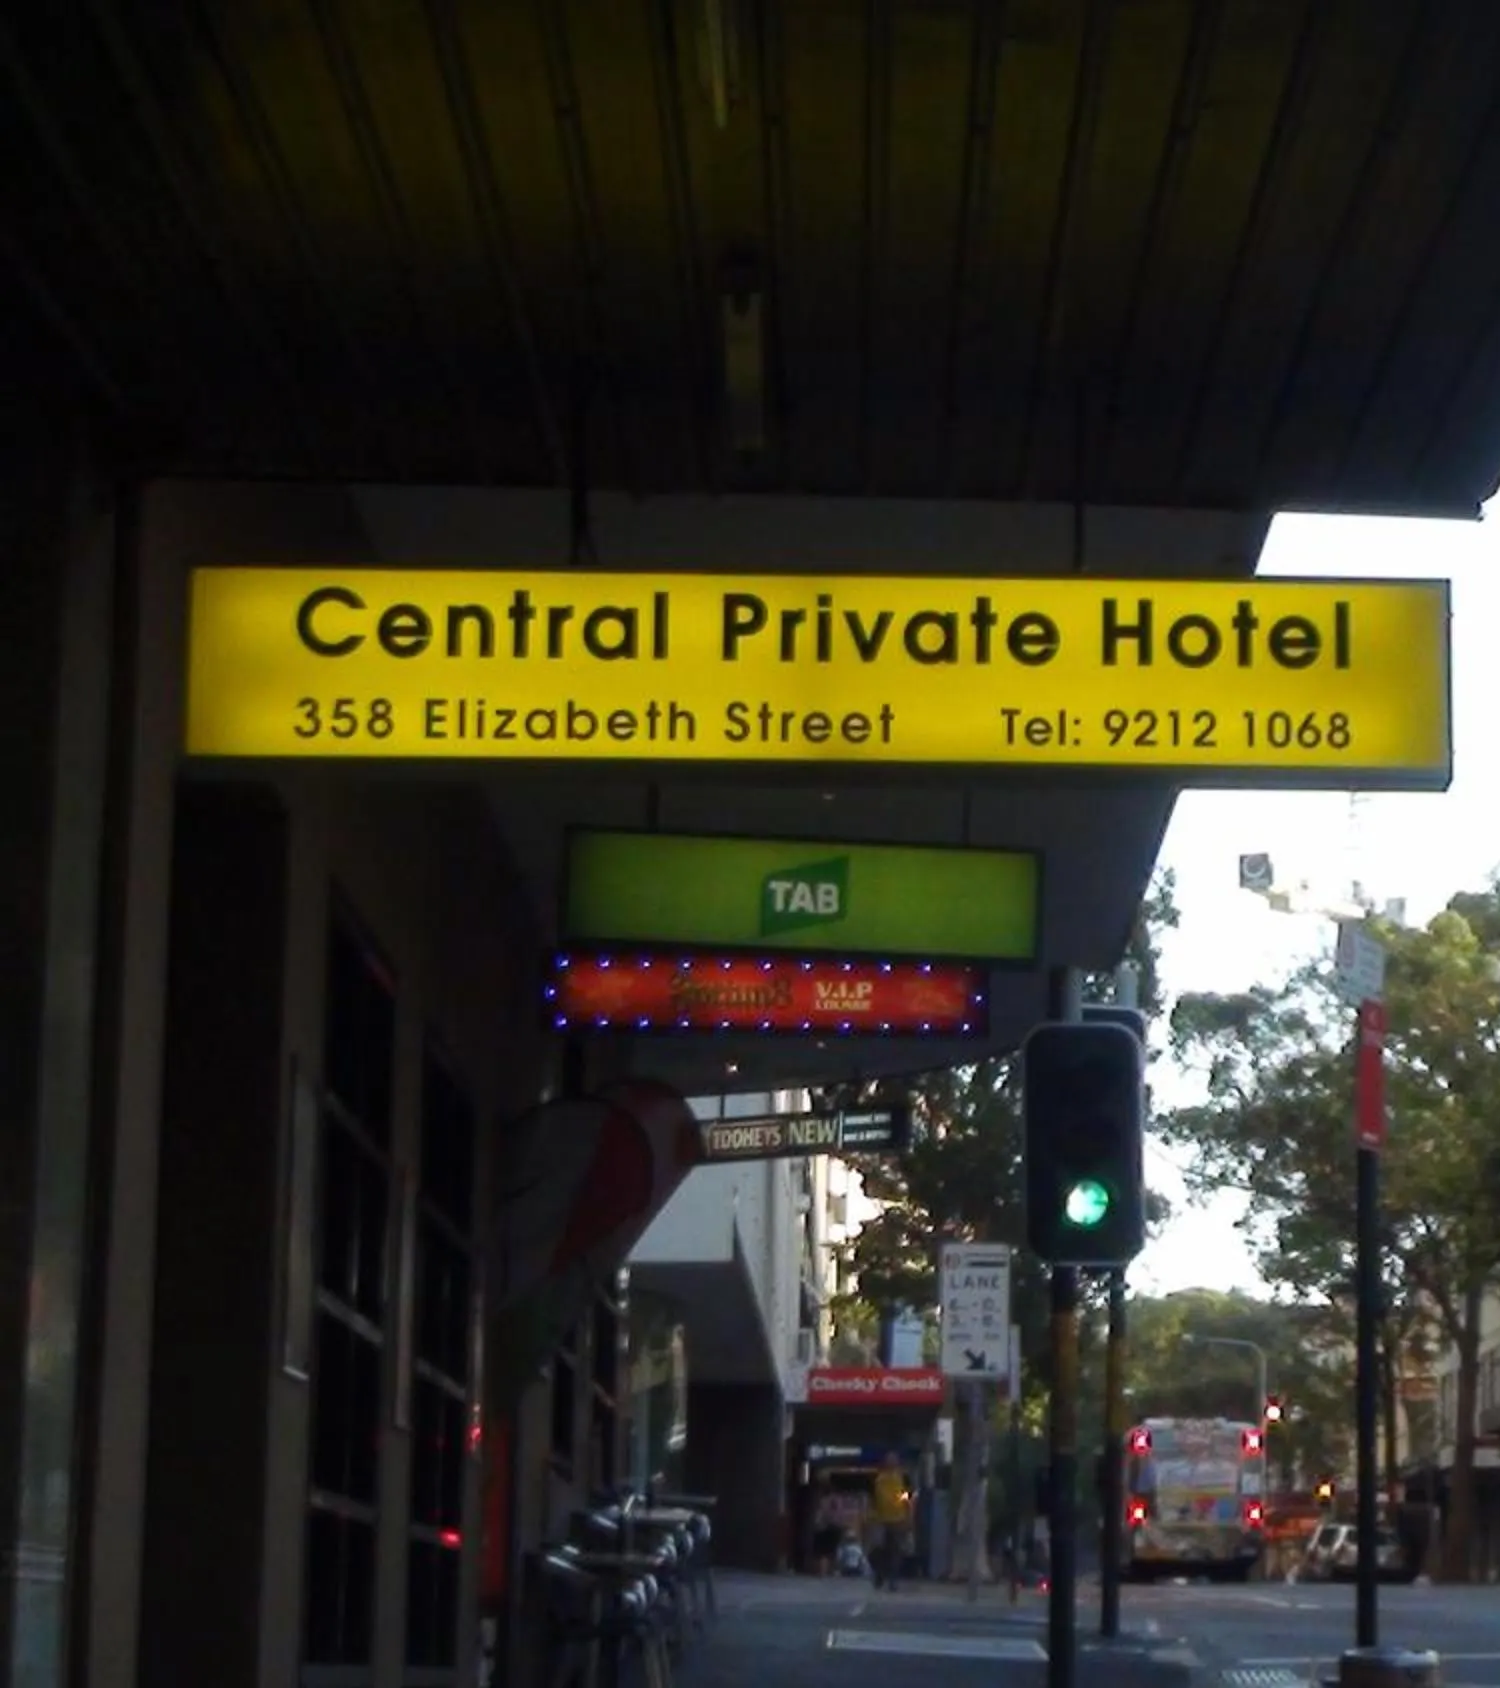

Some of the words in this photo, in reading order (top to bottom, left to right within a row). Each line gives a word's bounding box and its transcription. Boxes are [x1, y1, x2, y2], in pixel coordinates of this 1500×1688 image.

[296, 586, 669, 660] Central
[722, 592, 1059, 666] Private
[1102, 598, 1350, 669] Hotel
[293, 698, 394, 739] 358
[424, 699, 697, 742] Elizabeth
[723, 703, 895, 744] Street
[1001, 708, 1082, 747] Tel:
[1103, 710, 1218, 748] 9212
[1243, 711, 1351, 749] 1068
[767, 880, 840, 914] TAB
[712, 1126, 781, 1149] TOOHEYS
[788, 1119, 837, 1145] NEW
